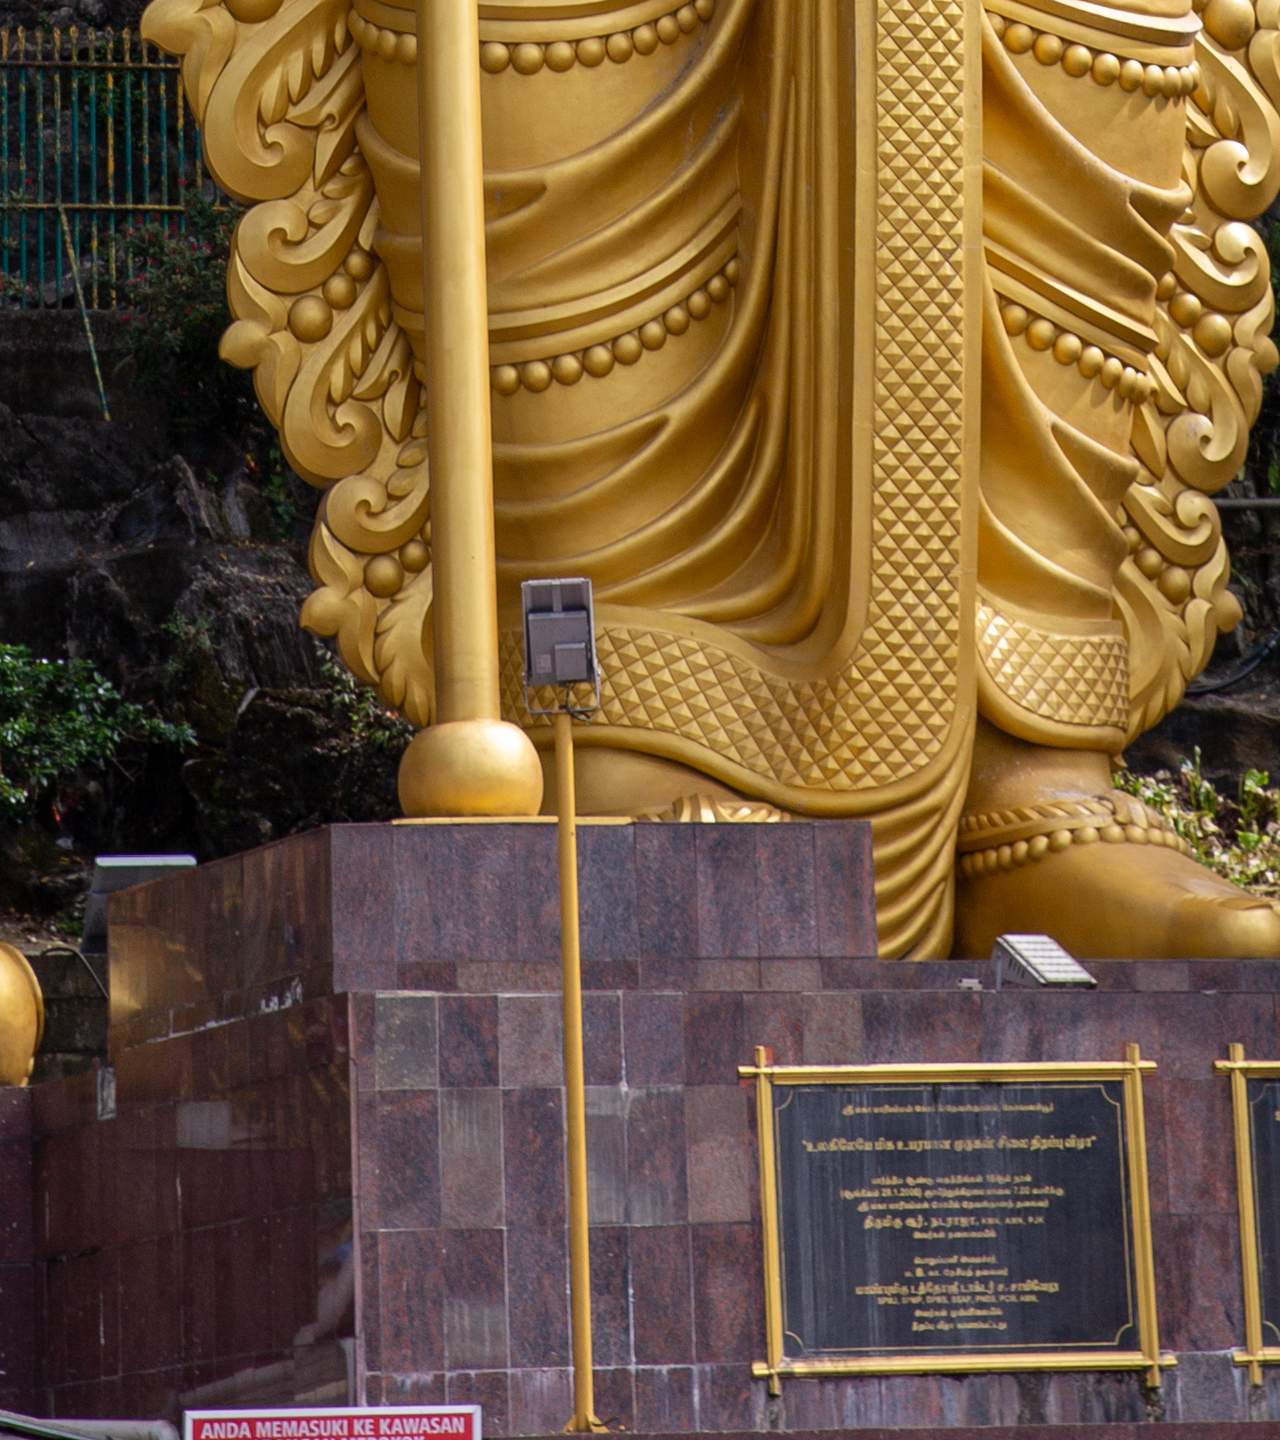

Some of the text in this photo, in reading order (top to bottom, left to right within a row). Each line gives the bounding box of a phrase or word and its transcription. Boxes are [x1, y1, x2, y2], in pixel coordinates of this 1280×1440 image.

[953, 1135, 994, 1152] முருகன்
[201, 1416, 465, 1439] ANDA MEMASUKI KE KAWASAN
